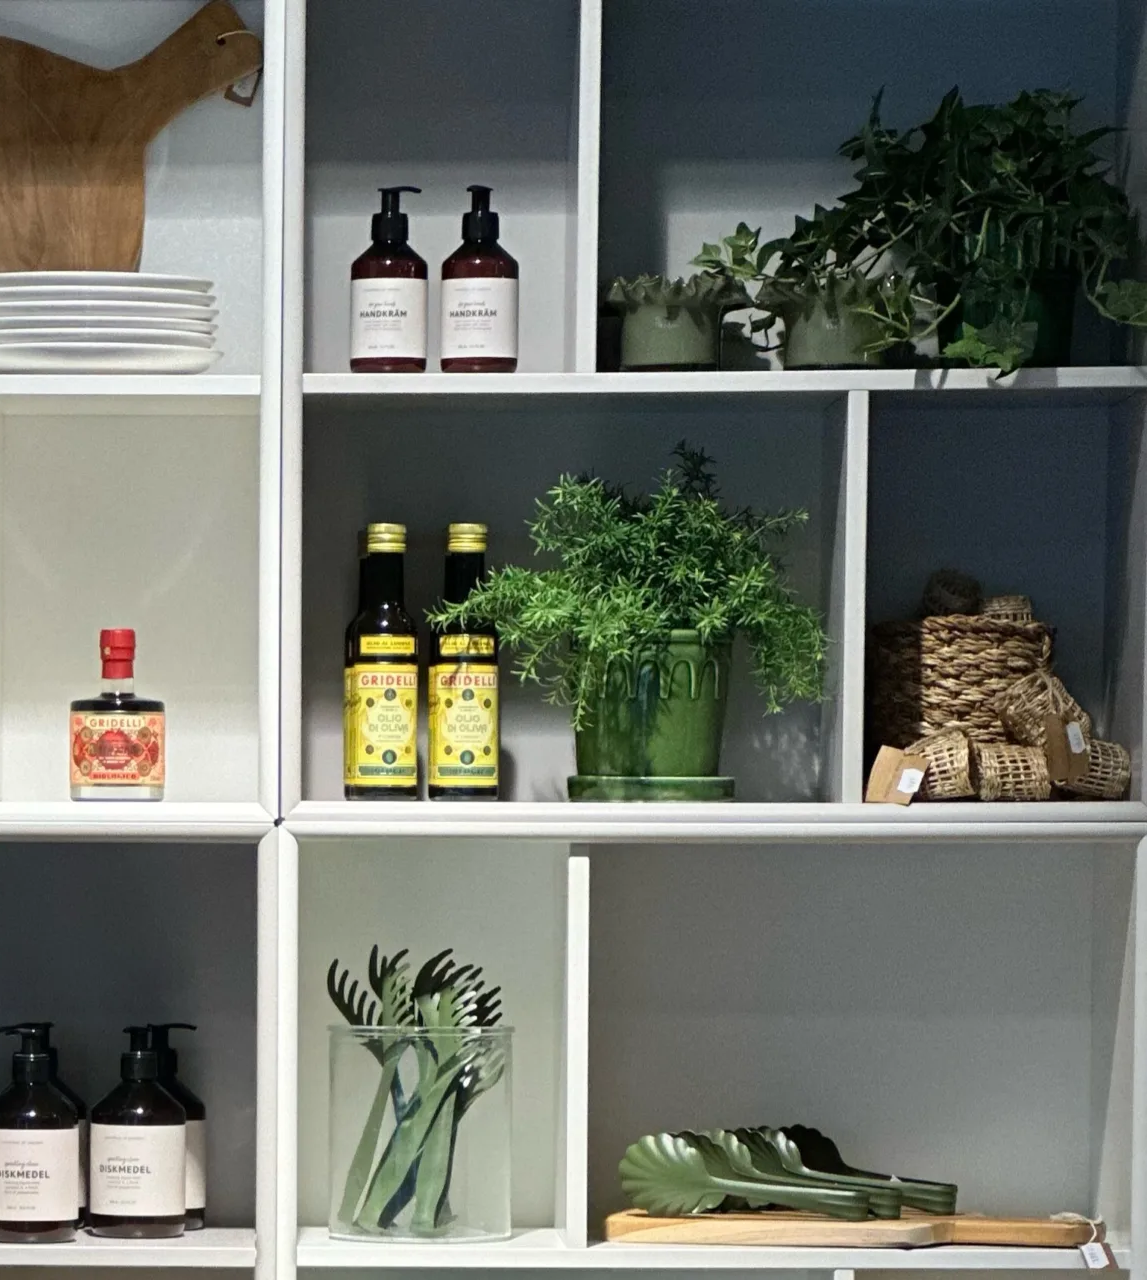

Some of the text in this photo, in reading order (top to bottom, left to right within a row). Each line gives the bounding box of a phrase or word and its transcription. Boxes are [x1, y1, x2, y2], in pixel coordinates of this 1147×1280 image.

[361, 674, 417, 686] GRIDELLI
[440, 675, 496, 687] GRIDELLI
[89, 718, 143, 728] GRIDELLI
[99, 1164, 152, 1175] DISKMEDEL
